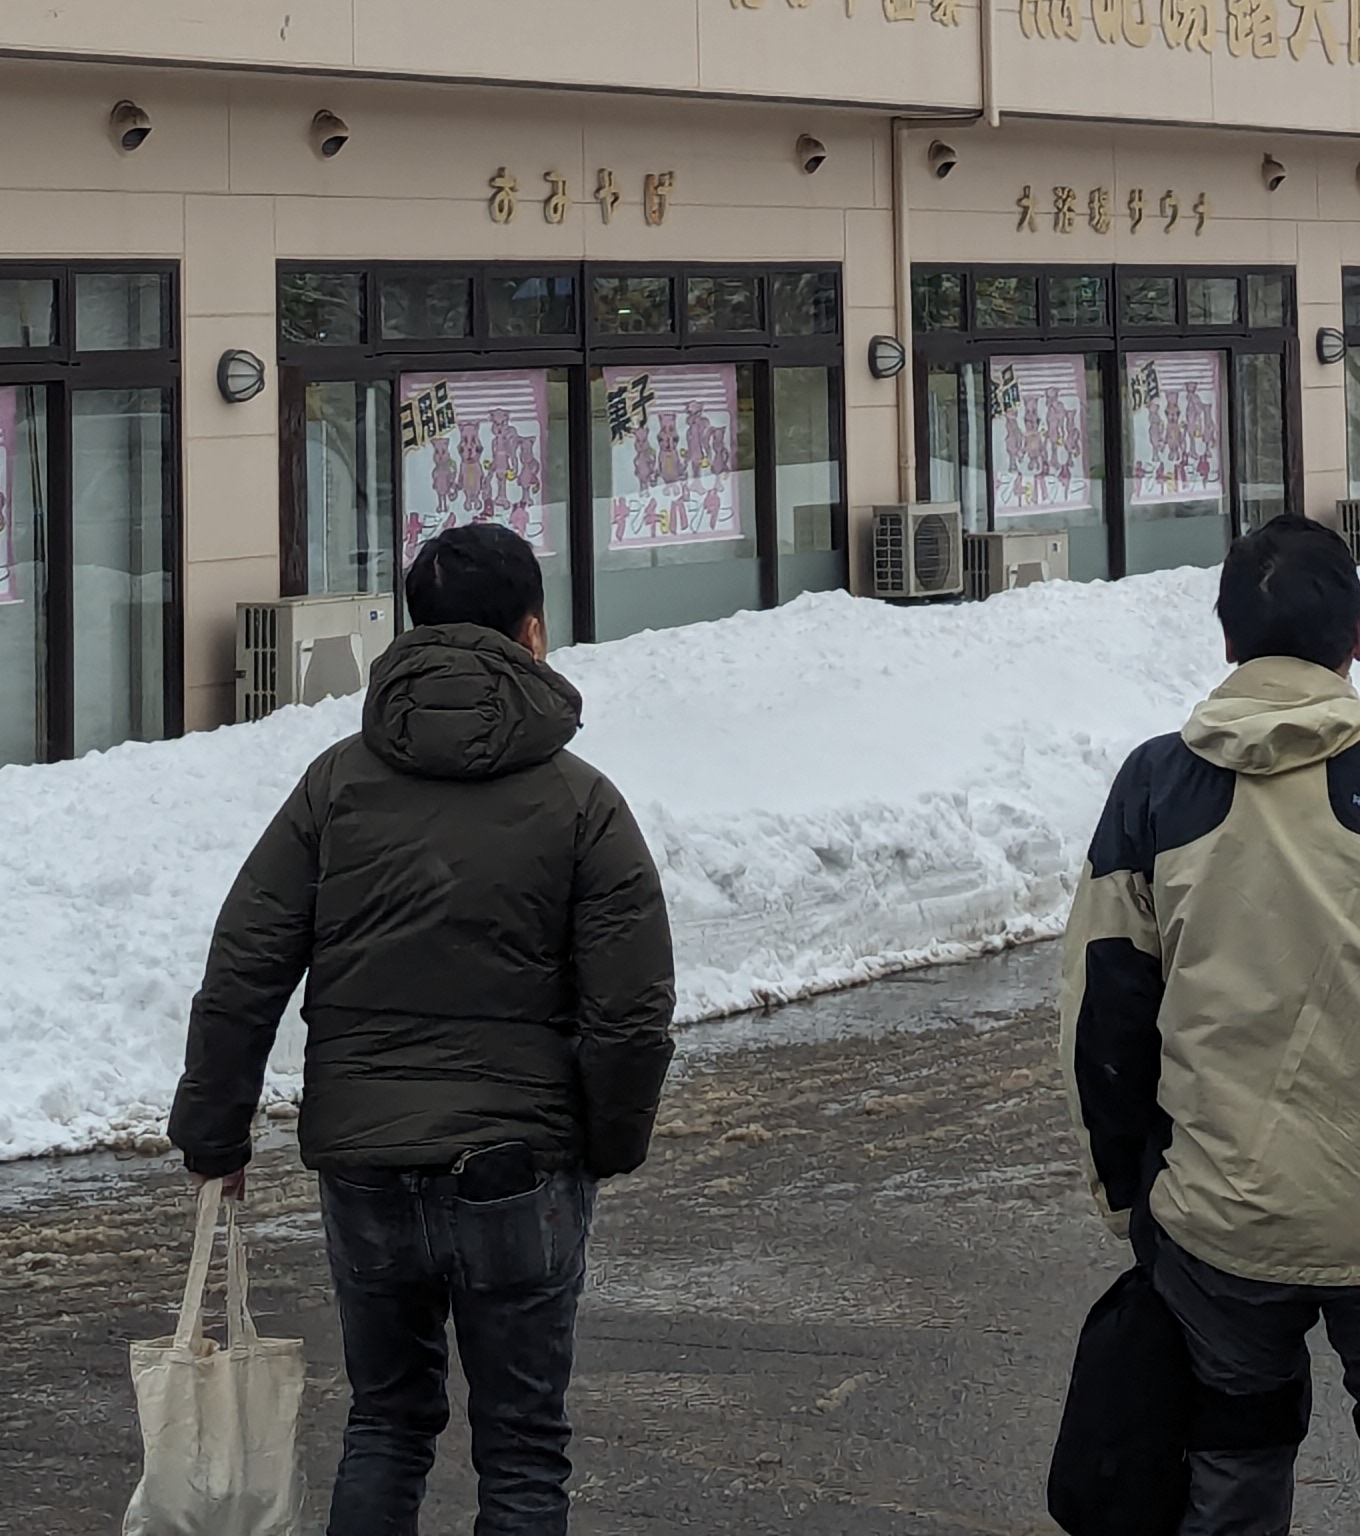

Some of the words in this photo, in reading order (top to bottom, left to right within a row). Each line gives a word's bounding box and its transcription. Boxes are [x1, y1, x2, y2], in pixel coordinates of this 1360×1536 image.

[489, 166, 675, 227] おみやげ
[1015, 184, 1212, 237] 大浴場サウナ
[400, 381, 455, 450] 日用品
[607, 375, 655, 441] 菓子
